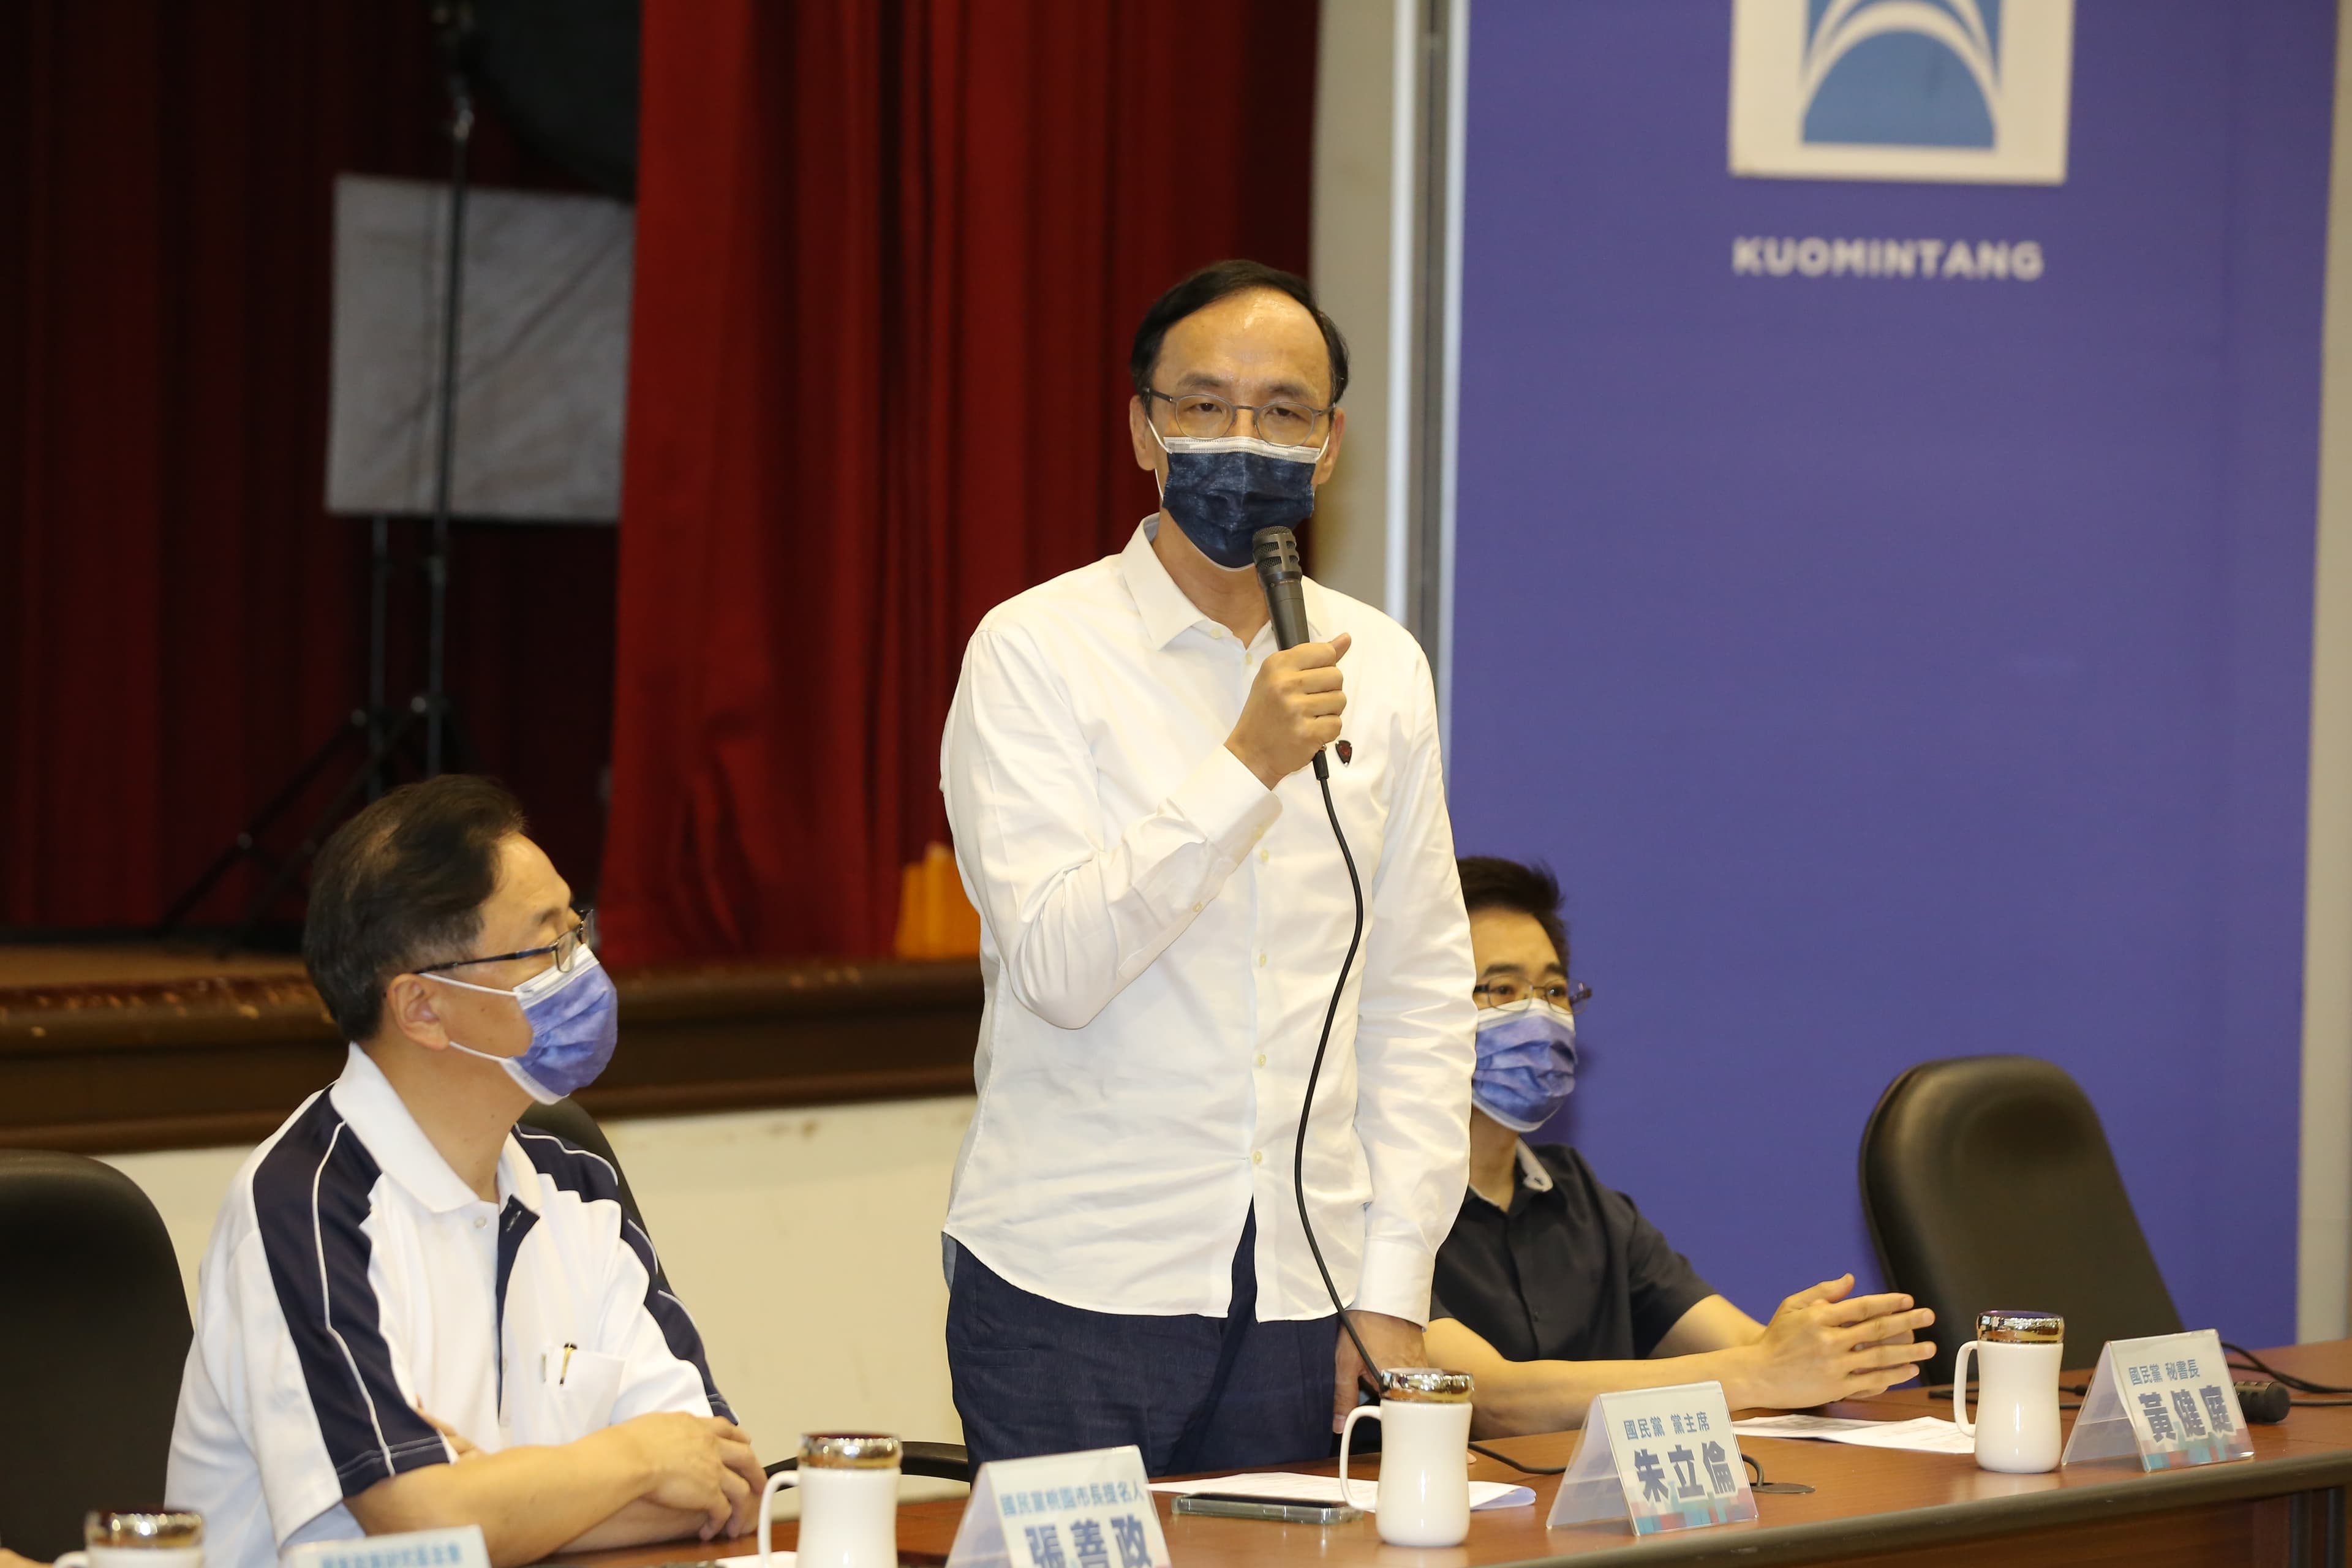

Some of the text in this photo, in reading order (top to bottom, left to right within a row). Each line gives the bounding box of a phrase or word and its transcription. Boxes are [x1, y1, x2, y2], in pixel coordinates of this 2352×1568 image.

[1732, 236, 2044, 282] KUOMINTANG
[2128, 1363, 2163, 1385] 國民黨
[1624, 1411, 1711, 1440] 國民黨 黨主席
[2138, 1385, 2234, 1442] 黃健庭
[1634, 1441, 1736, 1502] 朱立倫
